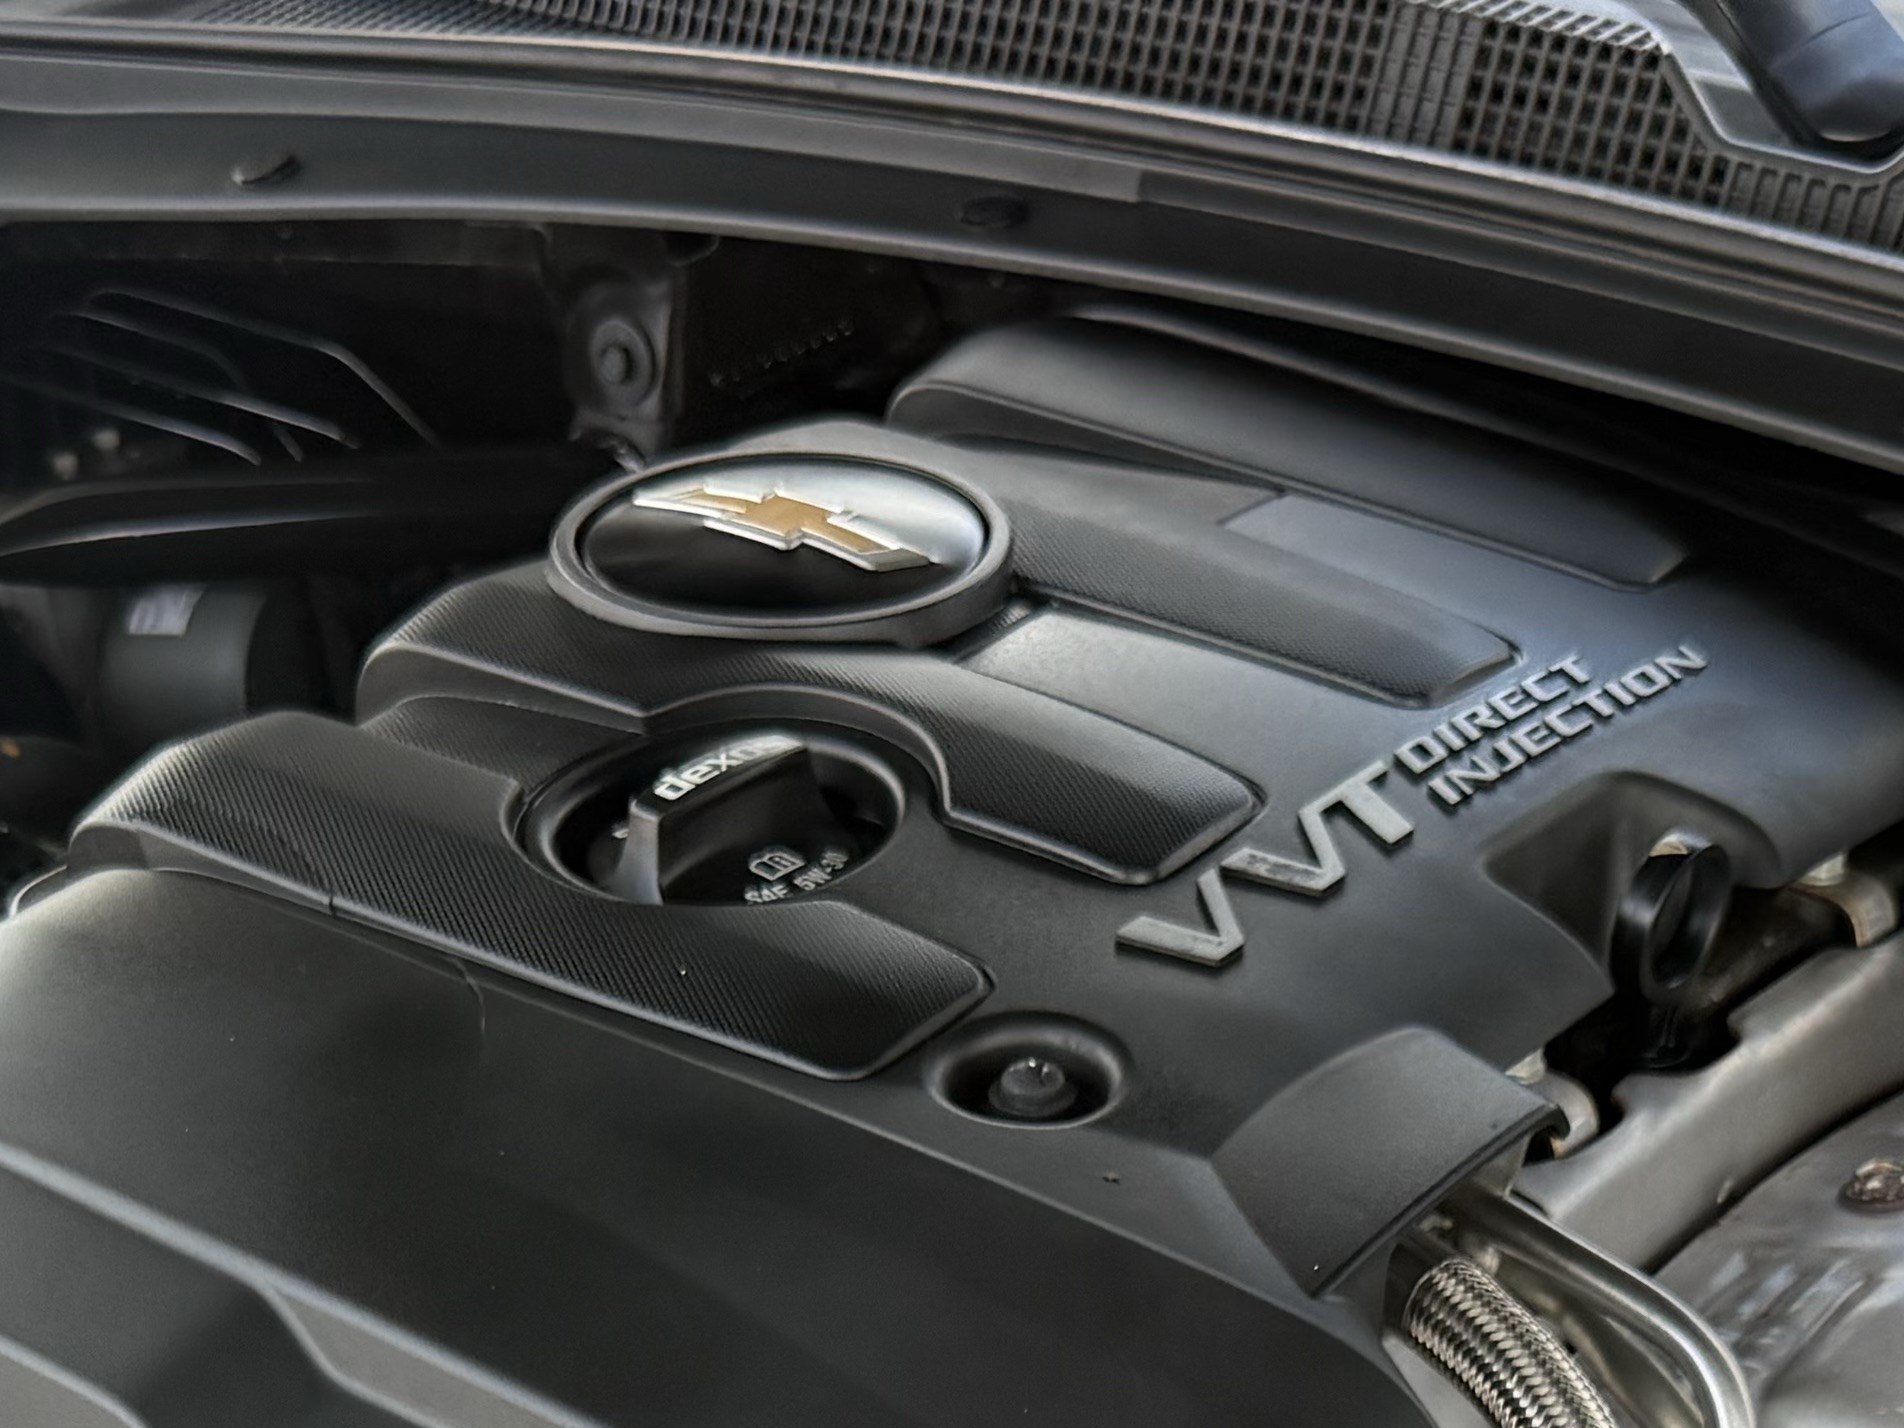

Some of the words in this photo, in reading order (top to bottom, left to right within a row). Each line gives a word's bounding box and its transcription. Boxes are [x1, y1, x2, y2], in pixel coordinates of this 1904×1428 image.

[1115, 758, 1416, 968] VVT
[1427, 643, 1709, 807] INJECTION
[1396, 653, 1594, 776] DIRECT
